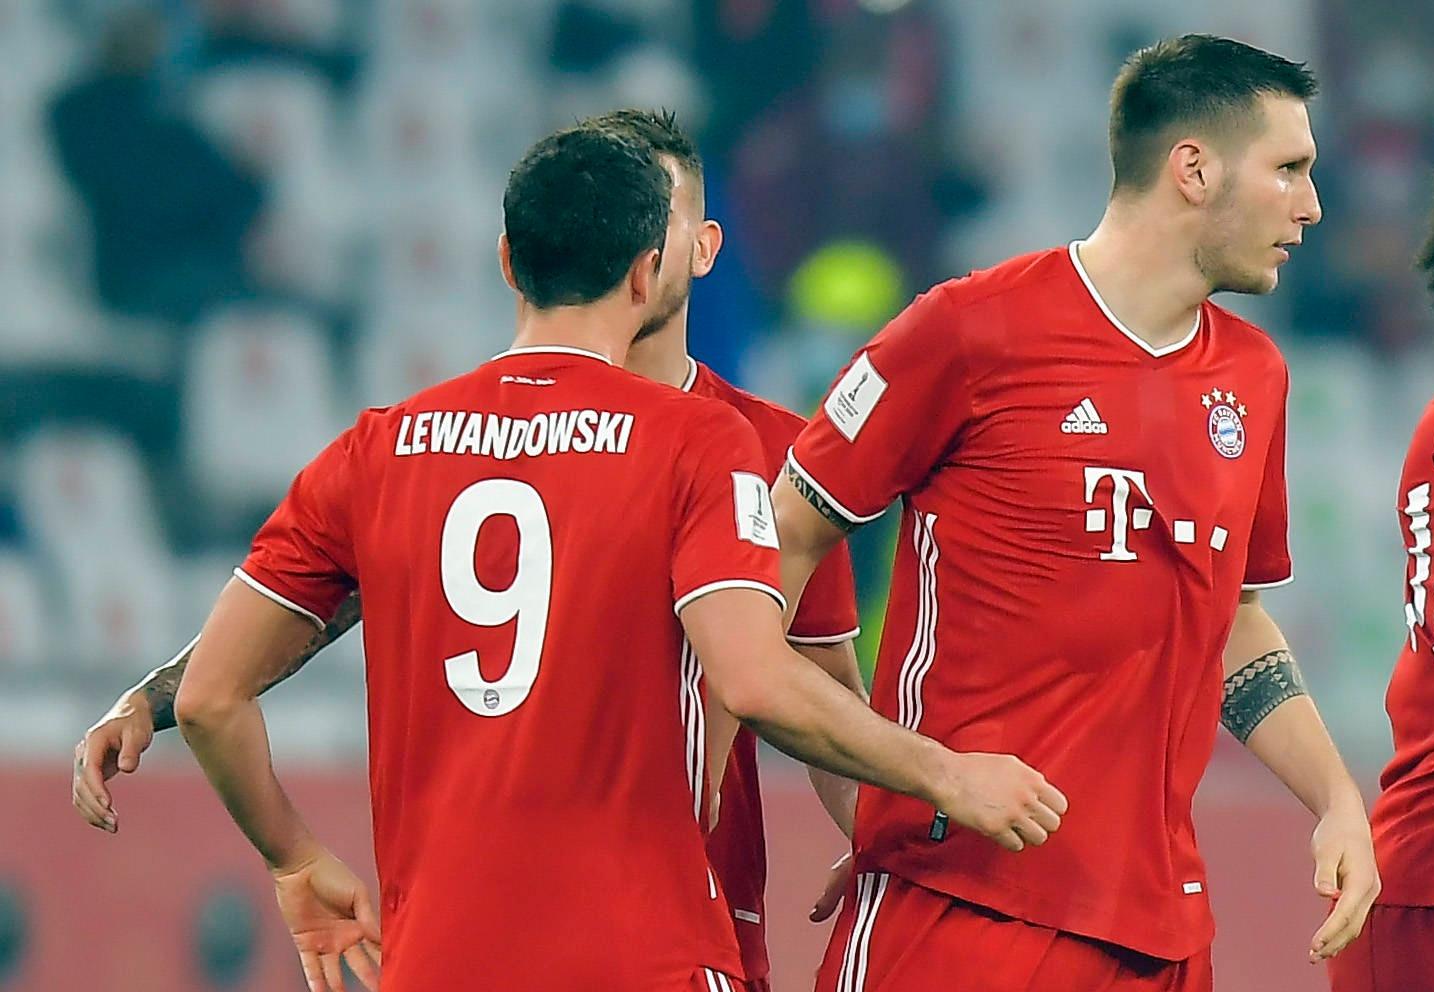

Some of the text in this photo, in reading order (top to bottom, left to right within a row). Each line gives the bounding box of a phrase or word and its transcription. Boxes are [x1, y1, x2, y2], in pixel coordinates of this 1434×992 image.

[393, 409, 635, 461] LEWANDOWSKI
[1060, 418, 1109, 434] adidas
[441, 478, 553, 718] 9
